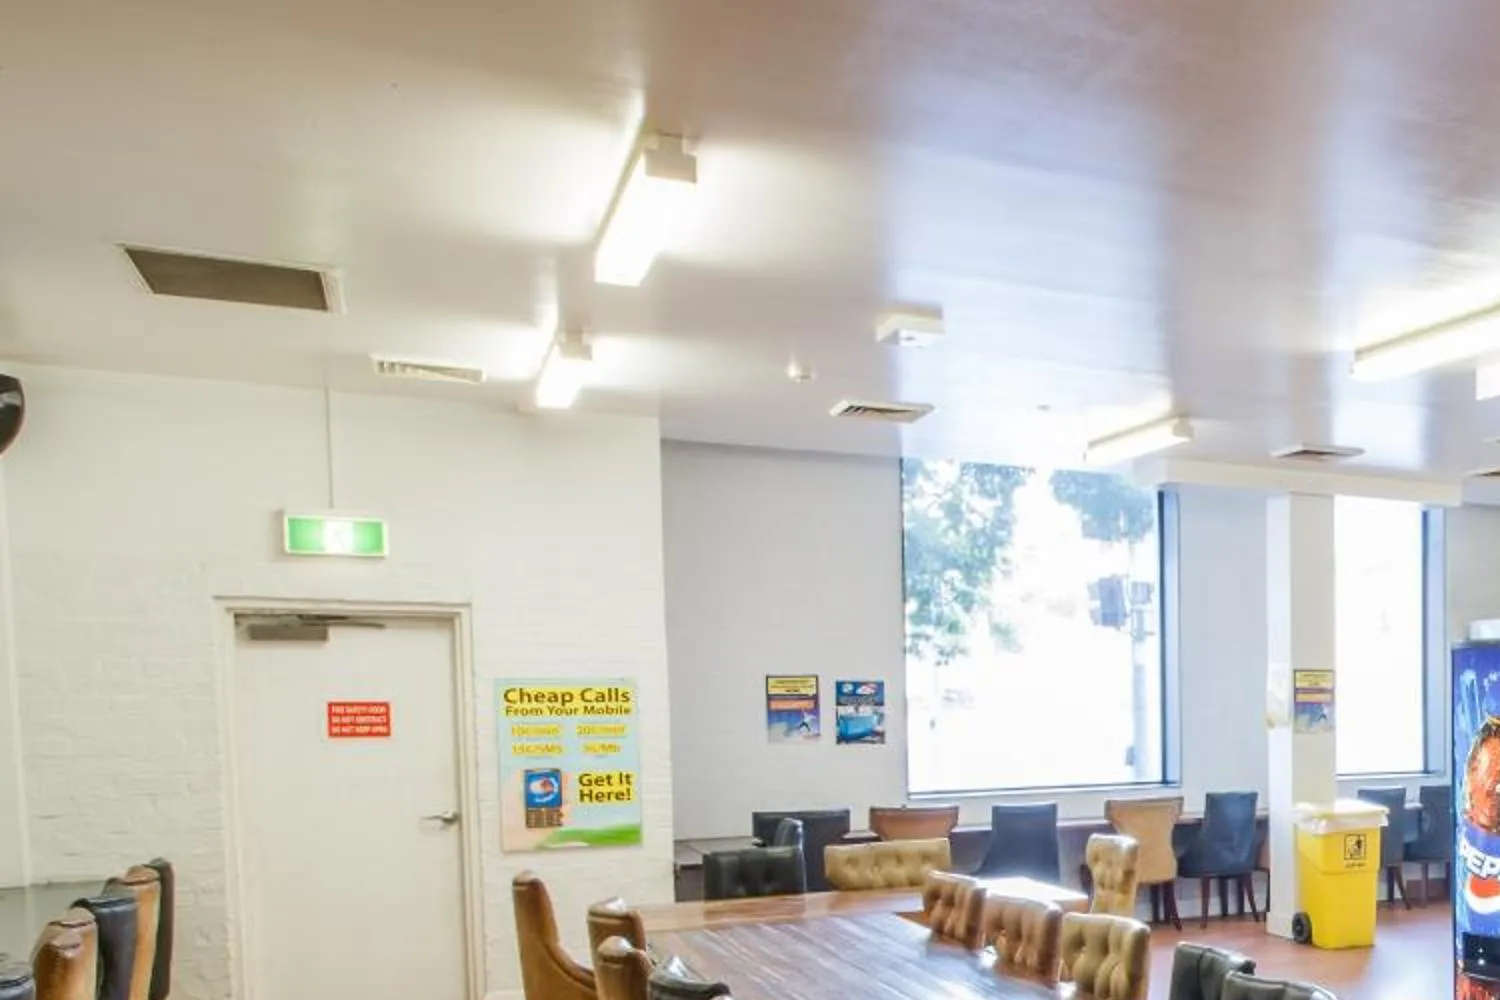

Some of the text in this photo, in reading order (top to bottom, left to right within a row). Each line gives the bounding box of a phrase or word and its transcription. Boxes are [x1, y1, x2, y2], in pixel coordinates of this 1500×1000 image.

[503, 687, 631, 706] Cheap Calls
[505, 704, 632, 716] From Your Mobile
[578, 772, 633, 788] Get It
[578, 787, 632, 803] Here!
